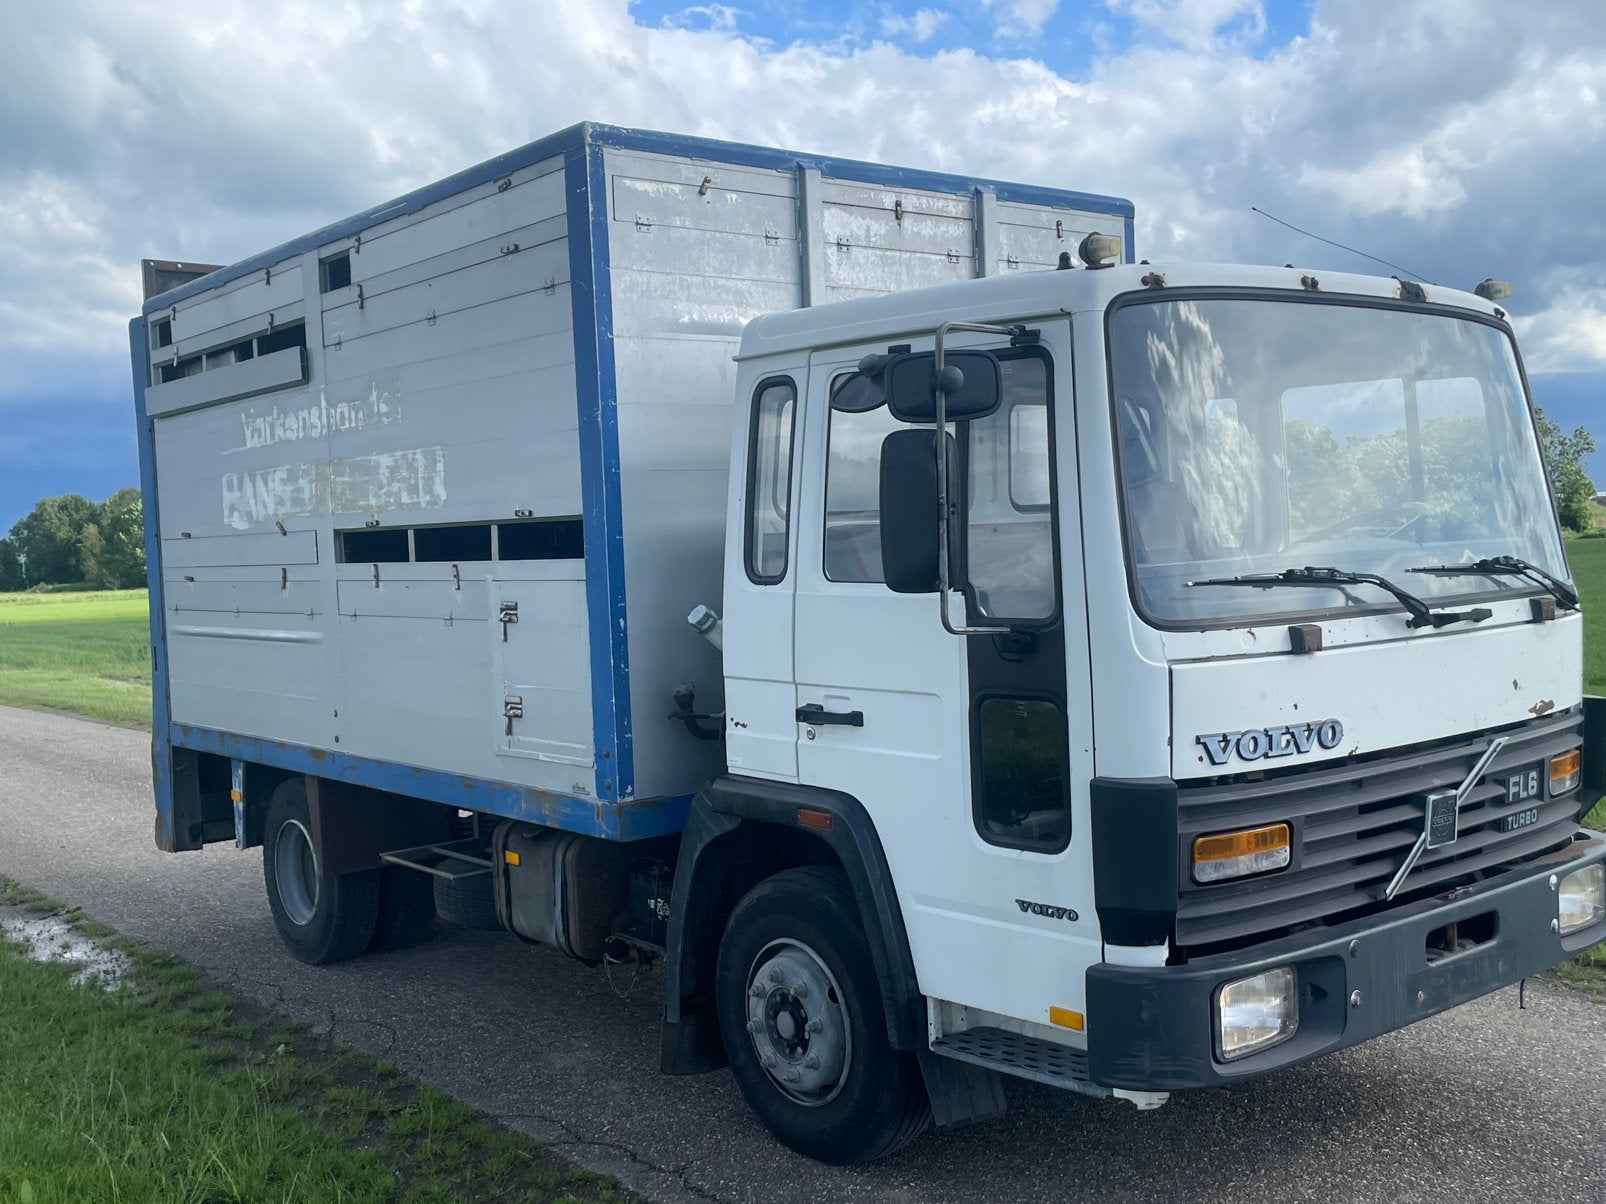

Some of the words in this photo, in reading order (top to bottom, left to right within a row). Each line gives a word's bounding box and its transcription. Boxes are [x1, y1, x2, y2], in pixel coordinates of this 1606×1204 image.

[1196, 718, 1343, 765] VOLVO
[1508, 770, 1538, 802] FL6
[1507, 809, 1538, 830] TURBO
[1015, 899, 1079, 922] VOLVO
